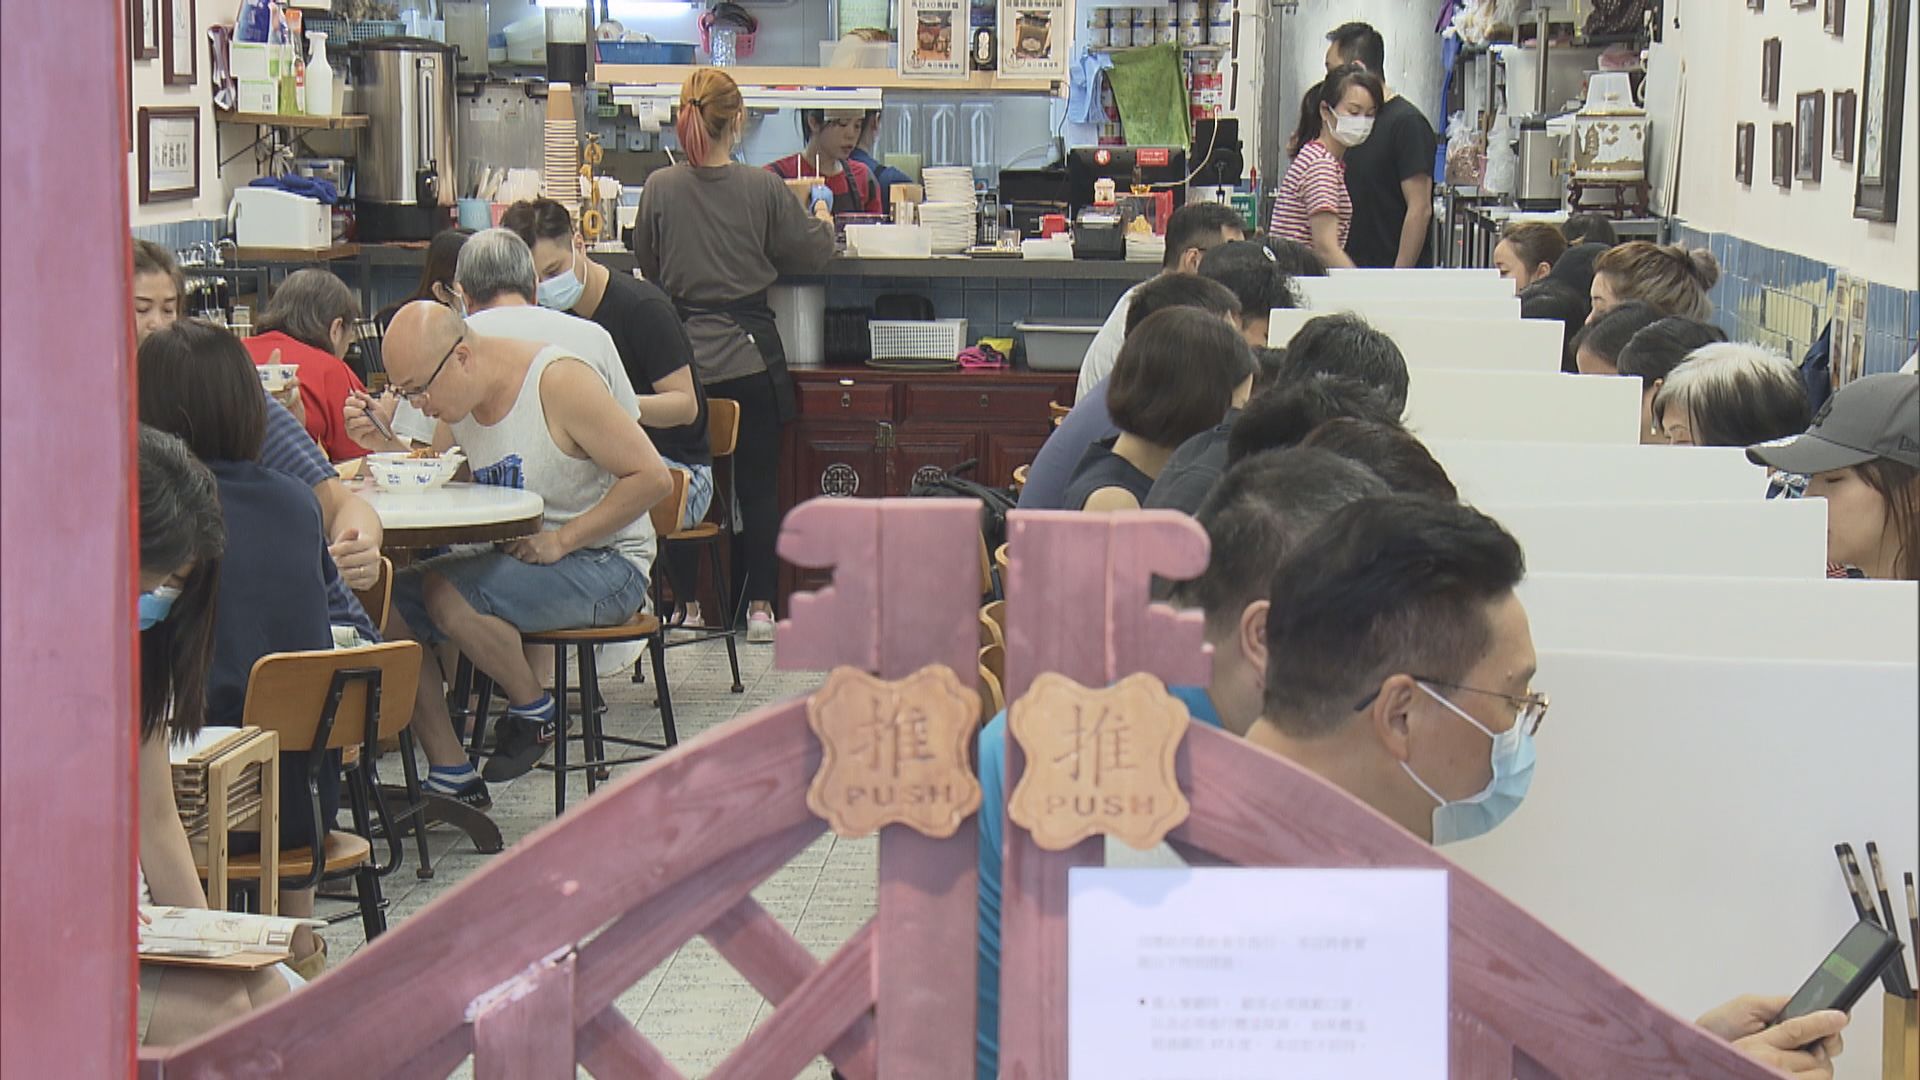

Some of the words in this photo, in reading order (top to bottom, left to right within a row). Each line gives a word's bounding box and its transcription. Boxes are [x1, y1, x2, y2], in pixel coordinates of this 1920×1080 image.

[849, 697, 935, 778] 推
[1053, 704, 1138, 787] 推
[846, 783, 953, 807] PUSH
[1045, 795, 1155, 817] PUSH
